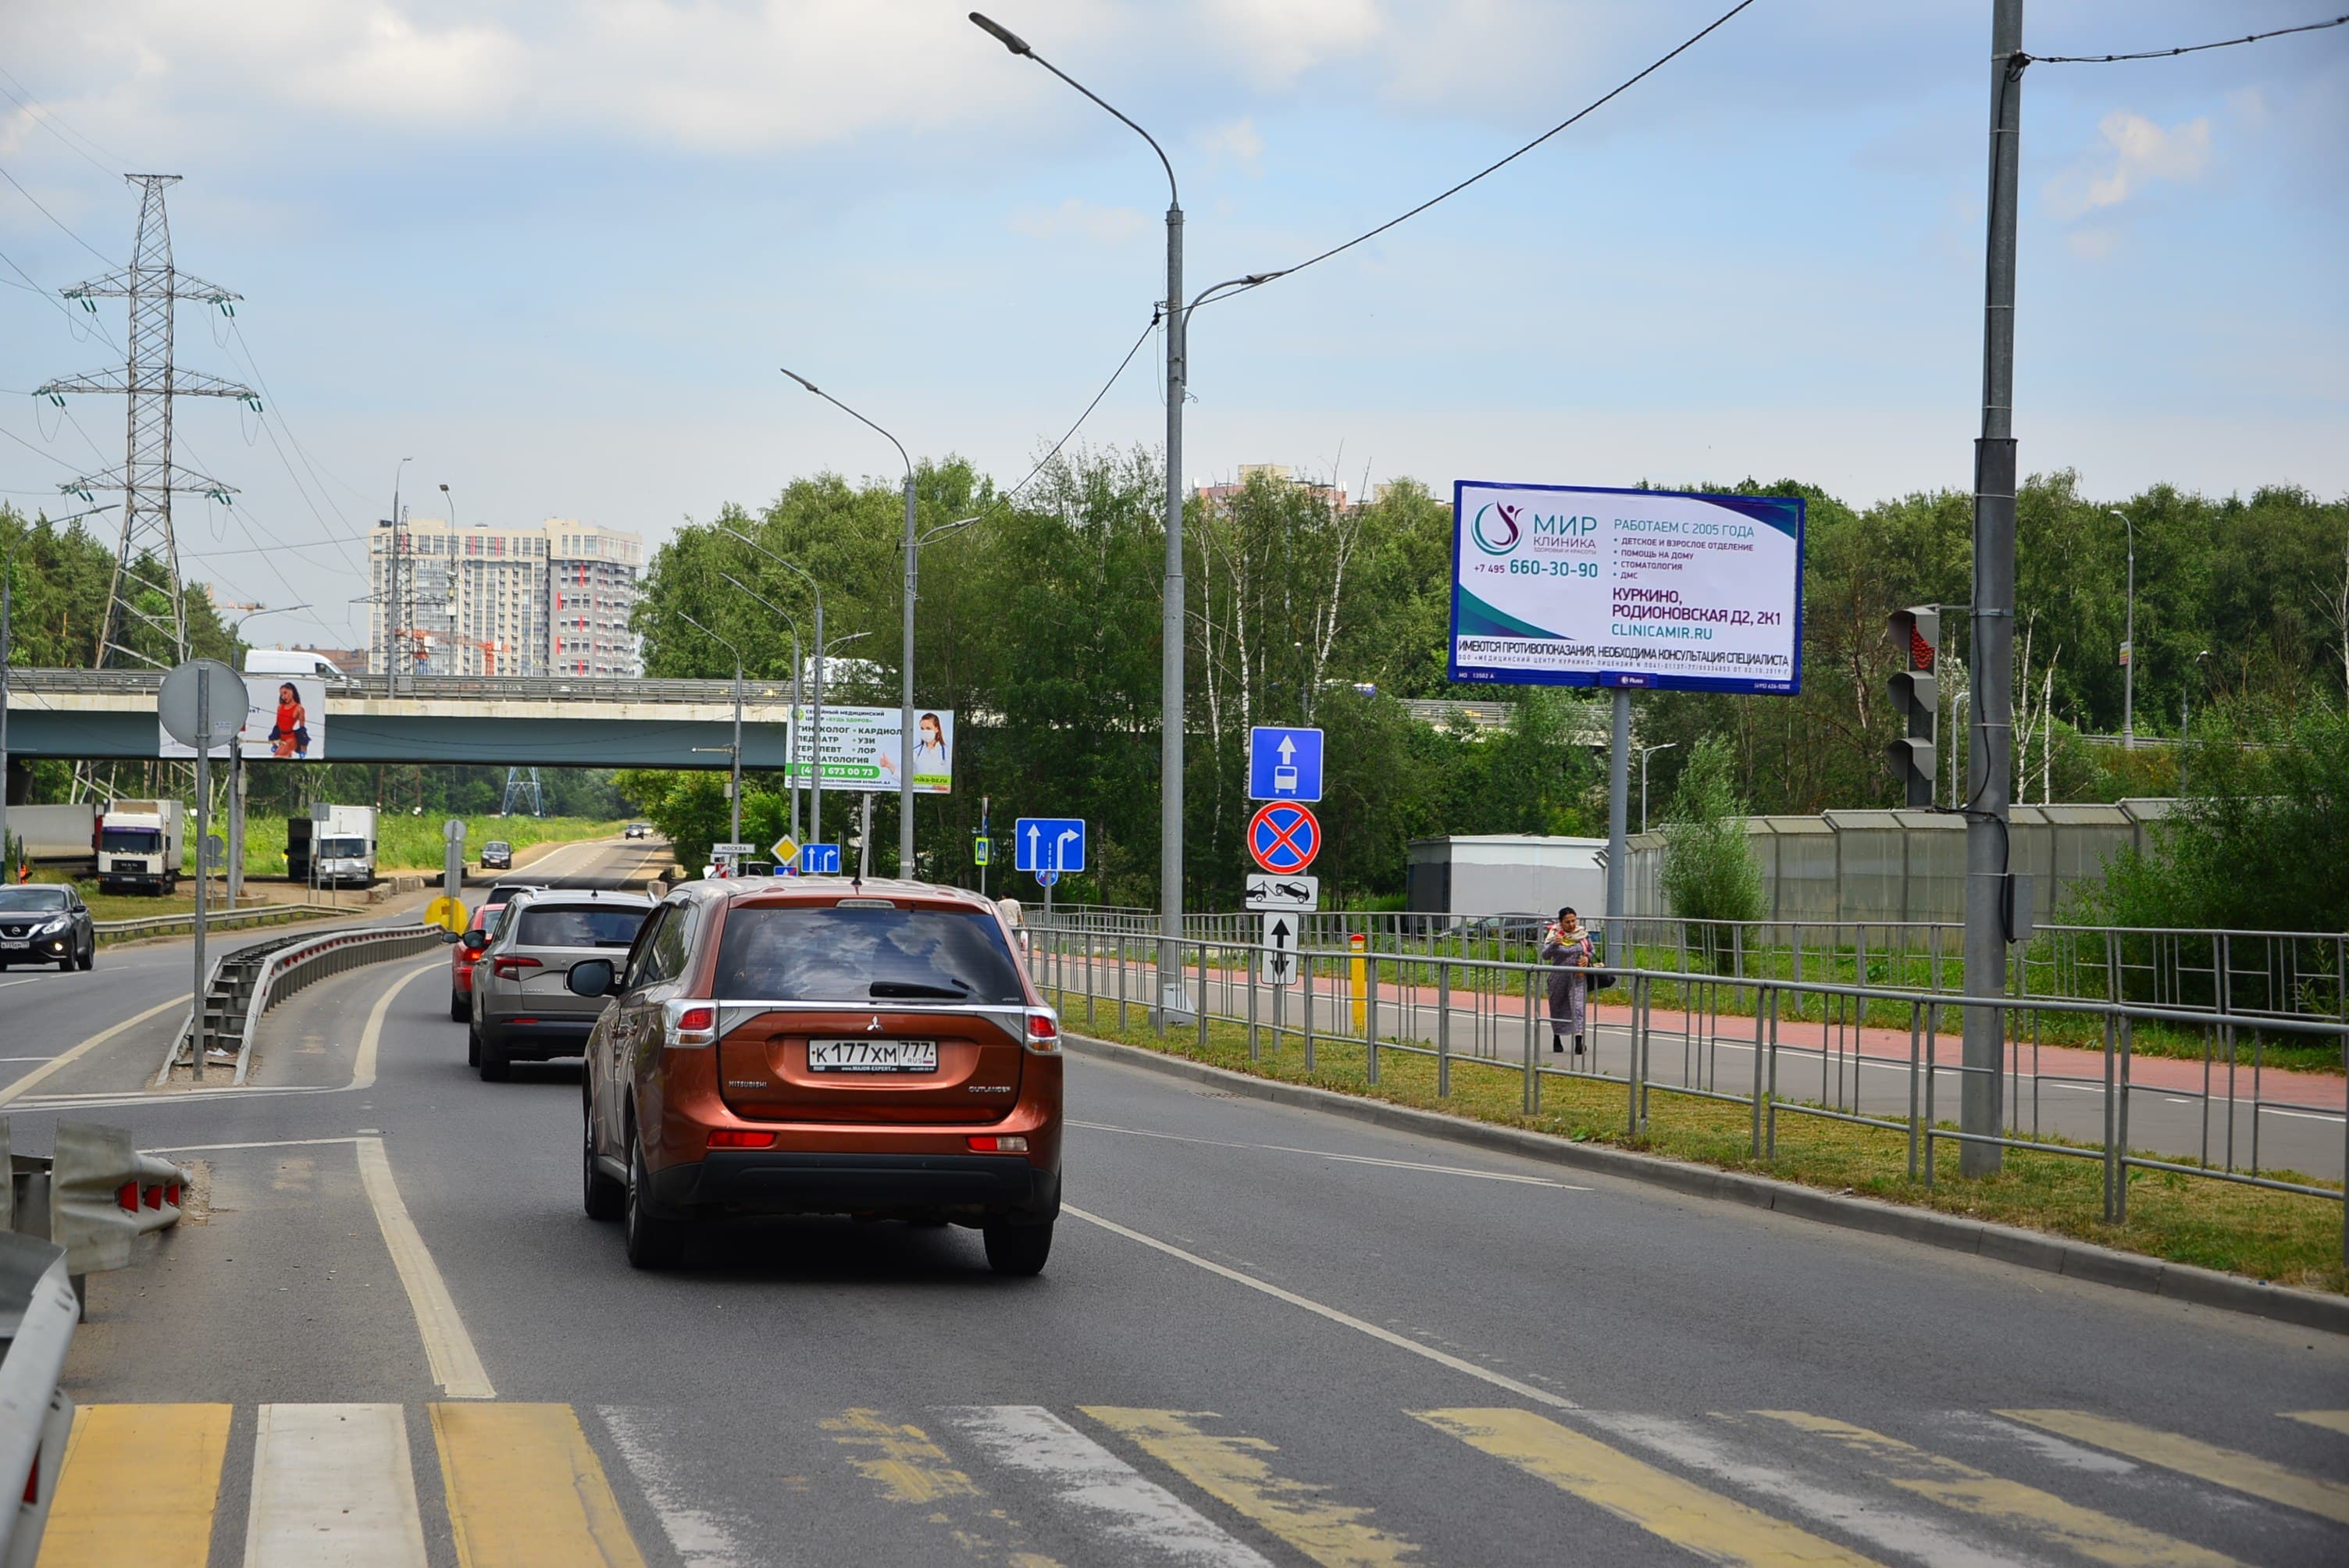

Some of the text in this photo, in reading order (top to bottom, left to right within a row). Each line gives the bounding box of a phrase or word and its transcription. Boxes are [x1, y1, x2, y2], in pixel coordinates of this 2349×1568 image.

[1534, 514, 1597, 536] МИР
[1614, 519, 1755, 538] РАБОТАЕМ С 2005 ГОДА
[1533, 536, 1596, 548] КЛИНИКА
[1621, 537, 1657, 547] ДЕТСКОЕ
[1666, 540, 1706, 549] ВЗРОСЛОЕ
[1708, 542, 1754, 551] ОТДЕЛЕНИЕ
[1621, 549, 1657, 558] ПОМОЩЬ
[1671, 552, 1694, 561] ДОМУ
[1474, 559, 1599, 578] +7 495 660-30-90
[1620, 561, 1683, 570] СТОМАТОЛОГИЯ
[1613, 587, 1682, 605] КУРКИНО,
[1612, 604, 1780, 626] РОДИОНОВСКАЯ Д2, 2К1
[1611, 624, 1713, 640] CLINICAMIR.RU
[1459, 640, 1788, 667] ИМЕЮТСЯ ПРОТИВОПОКАЗАНИЯ, НЕОБХОДИМА КОНСУЛЬТАЦИЯ СПЕЦИАЛИСТА
[797, 754, 869, 763] СТОАТОЛОГИЯ
[900, 1042, 930, 1058] 777
